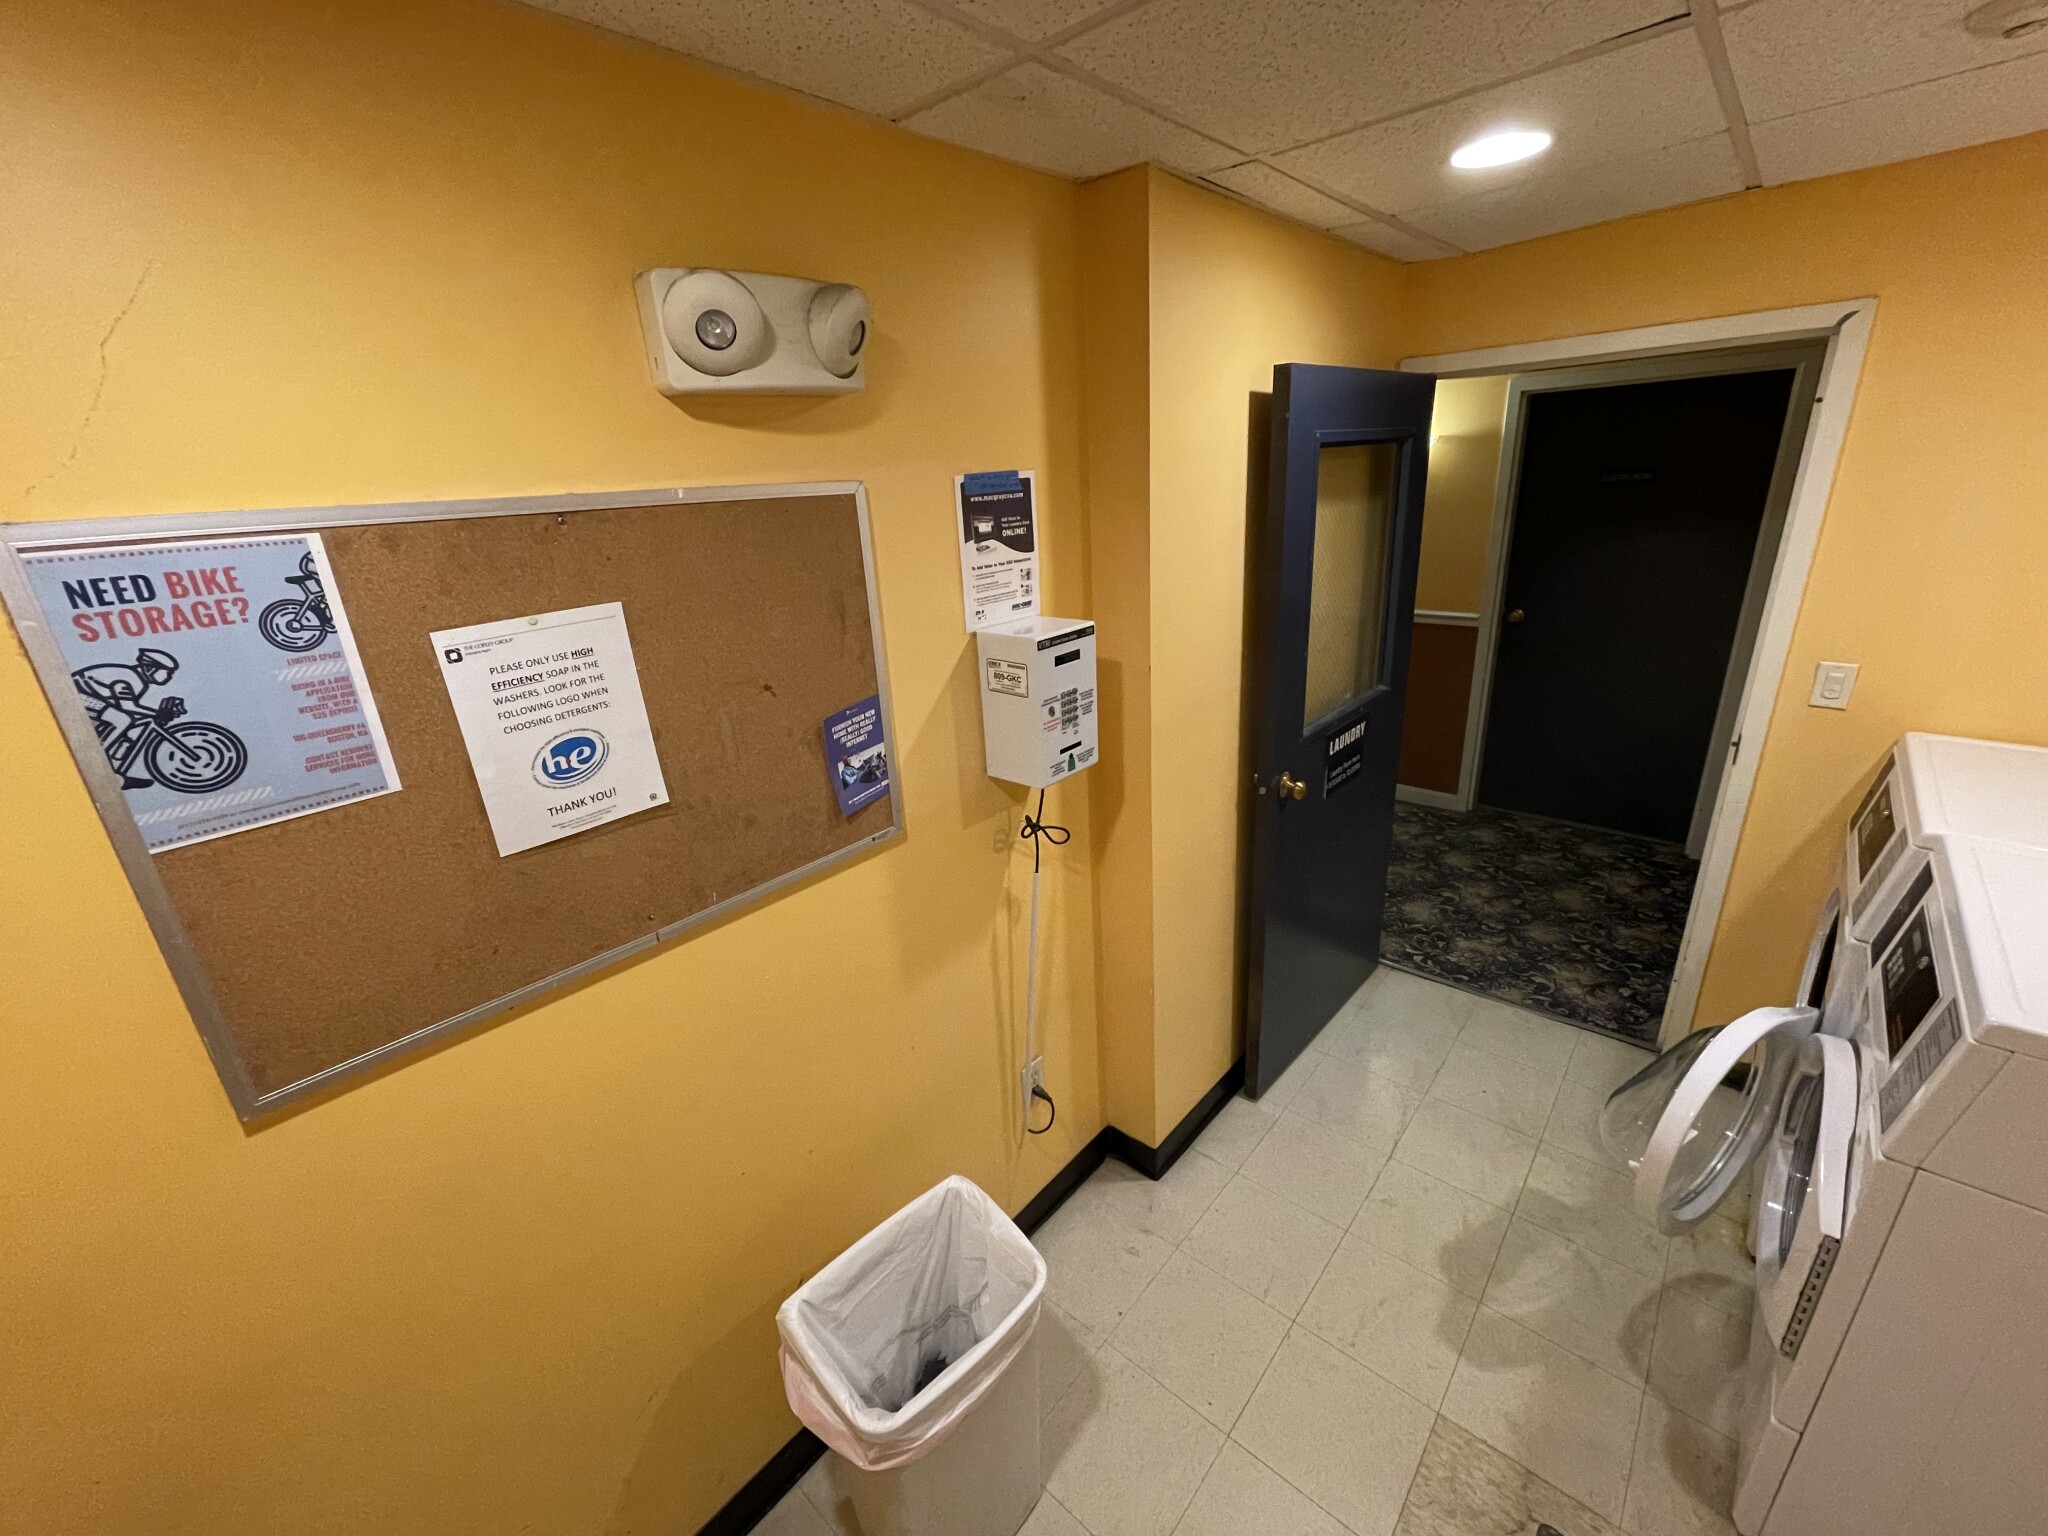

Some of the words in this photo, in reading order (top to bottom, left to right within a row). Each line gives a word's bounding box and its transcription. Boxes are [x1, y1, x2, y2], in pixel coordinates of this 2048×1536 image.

[1002, 526, 1026, 537] ONLINE!
[61, 574, 157, 610] NEED
[163, 566, 244, 599] BIKE
[71, 597, 249, 642] STORAGE?
[463, 643, 474, 652] THE
[494, 637, 514, 646] GROUP
[287, 654, 317, 666] LIMITED
[319, 651, 342, 661] SPACE
[489, 661, 524, 676] PLEASE
[525, 656, 550, 669] ONLY
[551, 651, 569, 662] USE
[570, 646, 594, 660] HIGH
[491, 673, 545, 692] EFFICIENCY
[545, 666, 569, 679] SOAP
[571, 664, 582, 673] IN
[583, 659, 600, 671] THE
[993, 671, 1022, 684] 809-GKC
[306, 683, 353, 697] APPLICATION
[492, 689, 542, 706] WASHERS.
[543, 682, 568, 695] LOOK
[569, 678, 588, 689] FOR
[588, 672, 605, 684] THE
[333, 699, 351, 708] WITH
[497, 700, 554, 721] FOLLOWING
[555, 694, 580, 707] LOGO
[581, 686, 609, 701] WHEN
[503, 715, 553, 735] CHOOSING
[554, 700, 612, 721] DETERGENTS:
[832, 719, 852, 734] FURNISH
[851, 713, 865, 724] YOUR
[865, 709, 875, 719] NEW
[833, 728, 848, 740] HOME
[847, 723, 860, 734] WITH
[860, 716, 876, 728] REALLY
[860, 724, 873, 735] GOOD
[845, 733, 868, 748] INTERNET
[1330, 721, 1367, 756] LAUNDRY
[304, 759, 340, 772] SERVICES
[305, 751, 339, 764] CONTACT
[543, 745, 592, 774] he
[547, 796, 588, 817] THANK
[588, 787, 617, 803] YOU!
